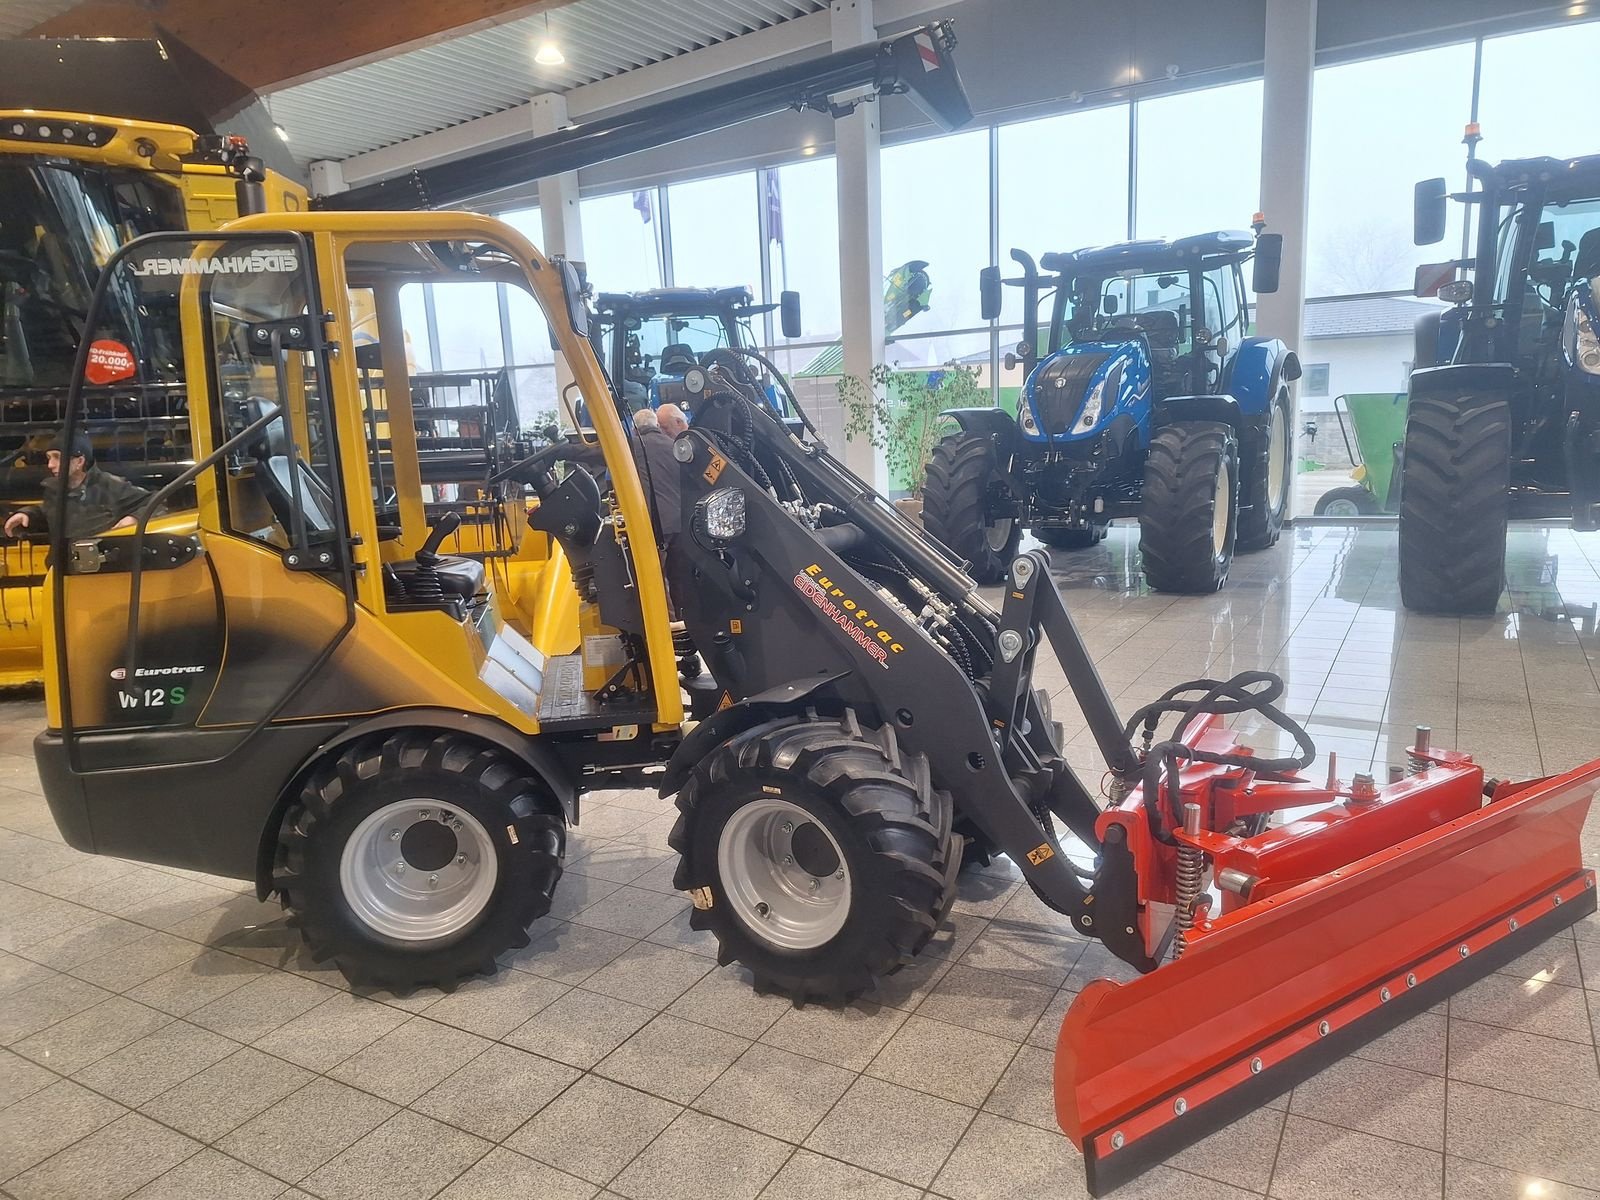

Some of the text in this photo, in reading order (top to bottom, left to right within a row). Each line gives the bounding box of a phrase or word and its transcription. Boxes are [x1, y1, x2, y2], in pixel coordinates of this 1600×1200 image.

[793, 574, 888, 664] EIDENHAMMER
[804, 563, 904, 653] Eurotrac
[134, 665, 205, 677] Eurotrac
[169, 686, 185, 705] S
